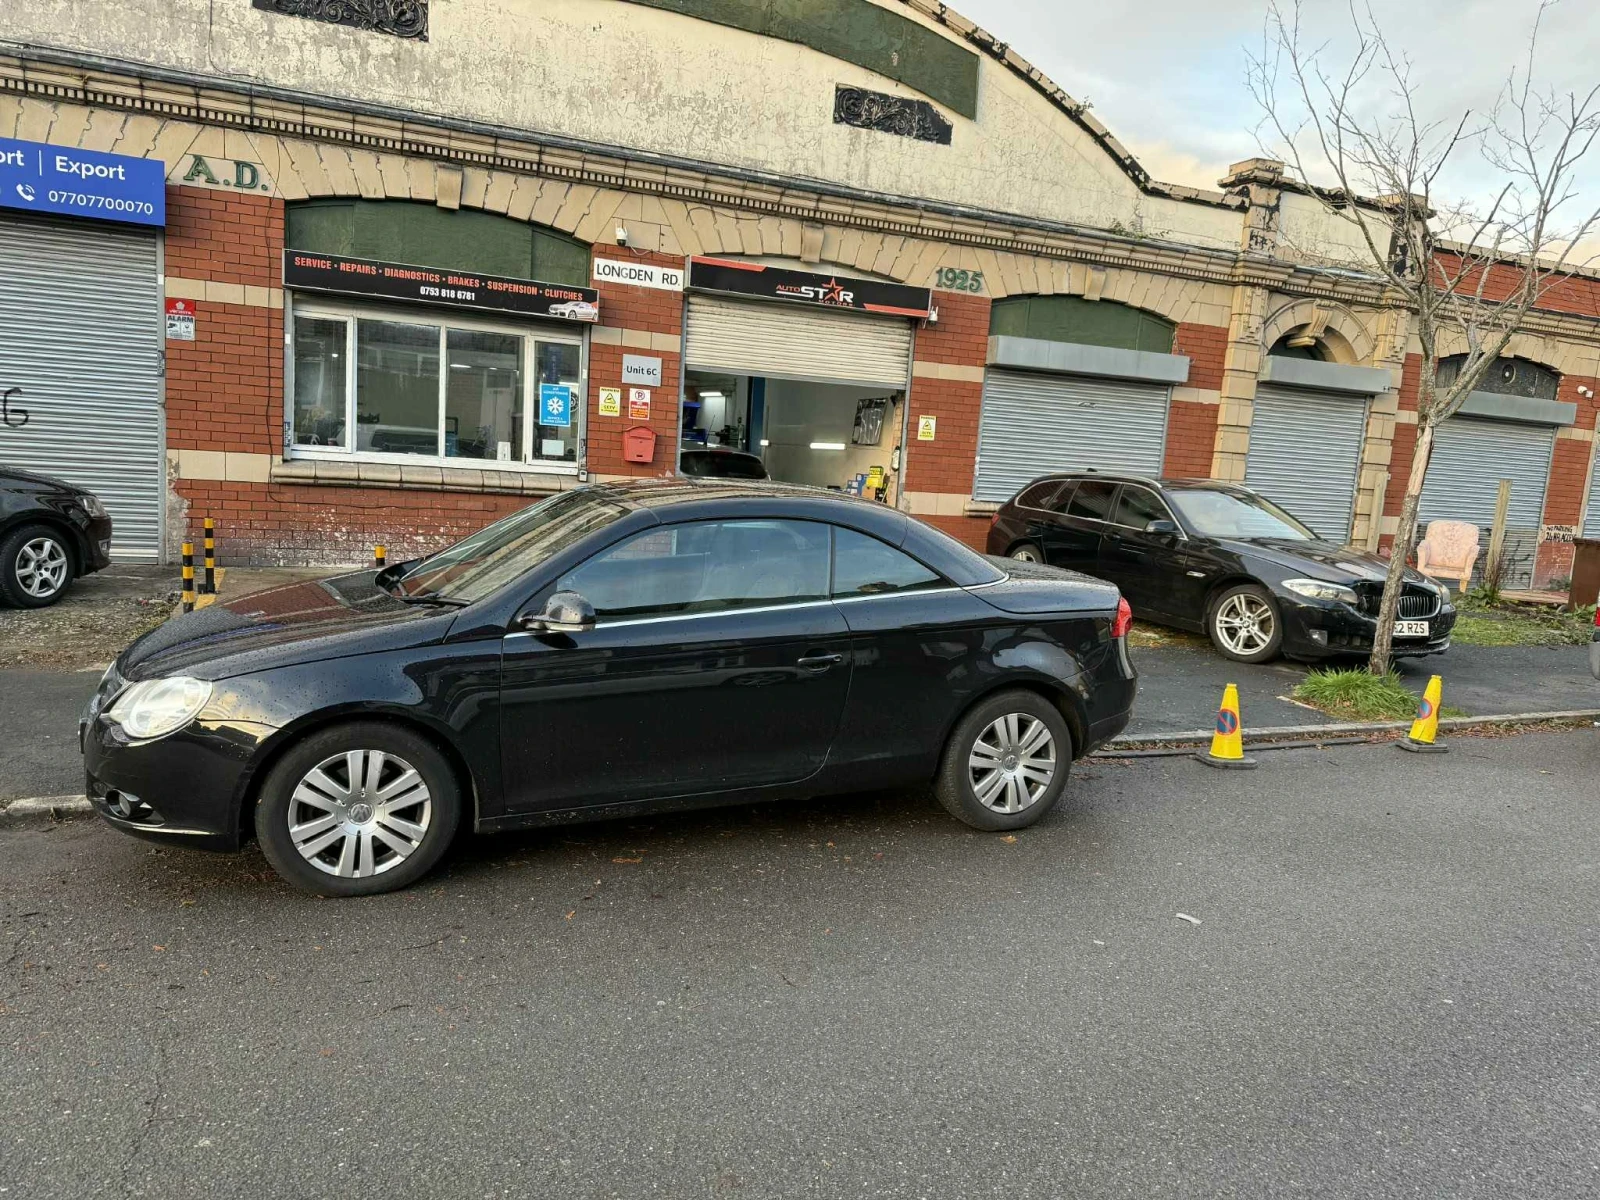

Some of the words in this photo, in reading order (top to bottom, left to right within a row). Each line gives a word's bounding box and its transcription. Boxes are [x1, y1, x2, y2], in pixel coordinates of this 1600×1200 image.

[55, 155, 126, 181] Export
[48, 190, 154, 215] 07707700070
[294, 256, 332, 270] SERVICE
[339, 262, 377, 275] REPAIRS
[384, 267, 440, 283] DIAGNOSTICS
[447, 275, 480, 288] BRAKES
[487, 280, 538, 296] SUSPENSION
[544, 288, 583, 301] CLUTCHES
[597, 263, 653, 283] LONGDEN
[661, 272, 681, 287] RD.
[935, 267, 984, 293] 1925
[420, 285, 440, 297] 0753
[441, 288, 455, 299] 818
[457, 290, 475, 301] 6781
[776, 284, 801, 293] AUTO
[168, 315, 194, 323] ALARM
[626, 365, 645, 375] Unit
[646, 368, 657, 376] 6C
[1407, 623, 1425, 634] RZS
